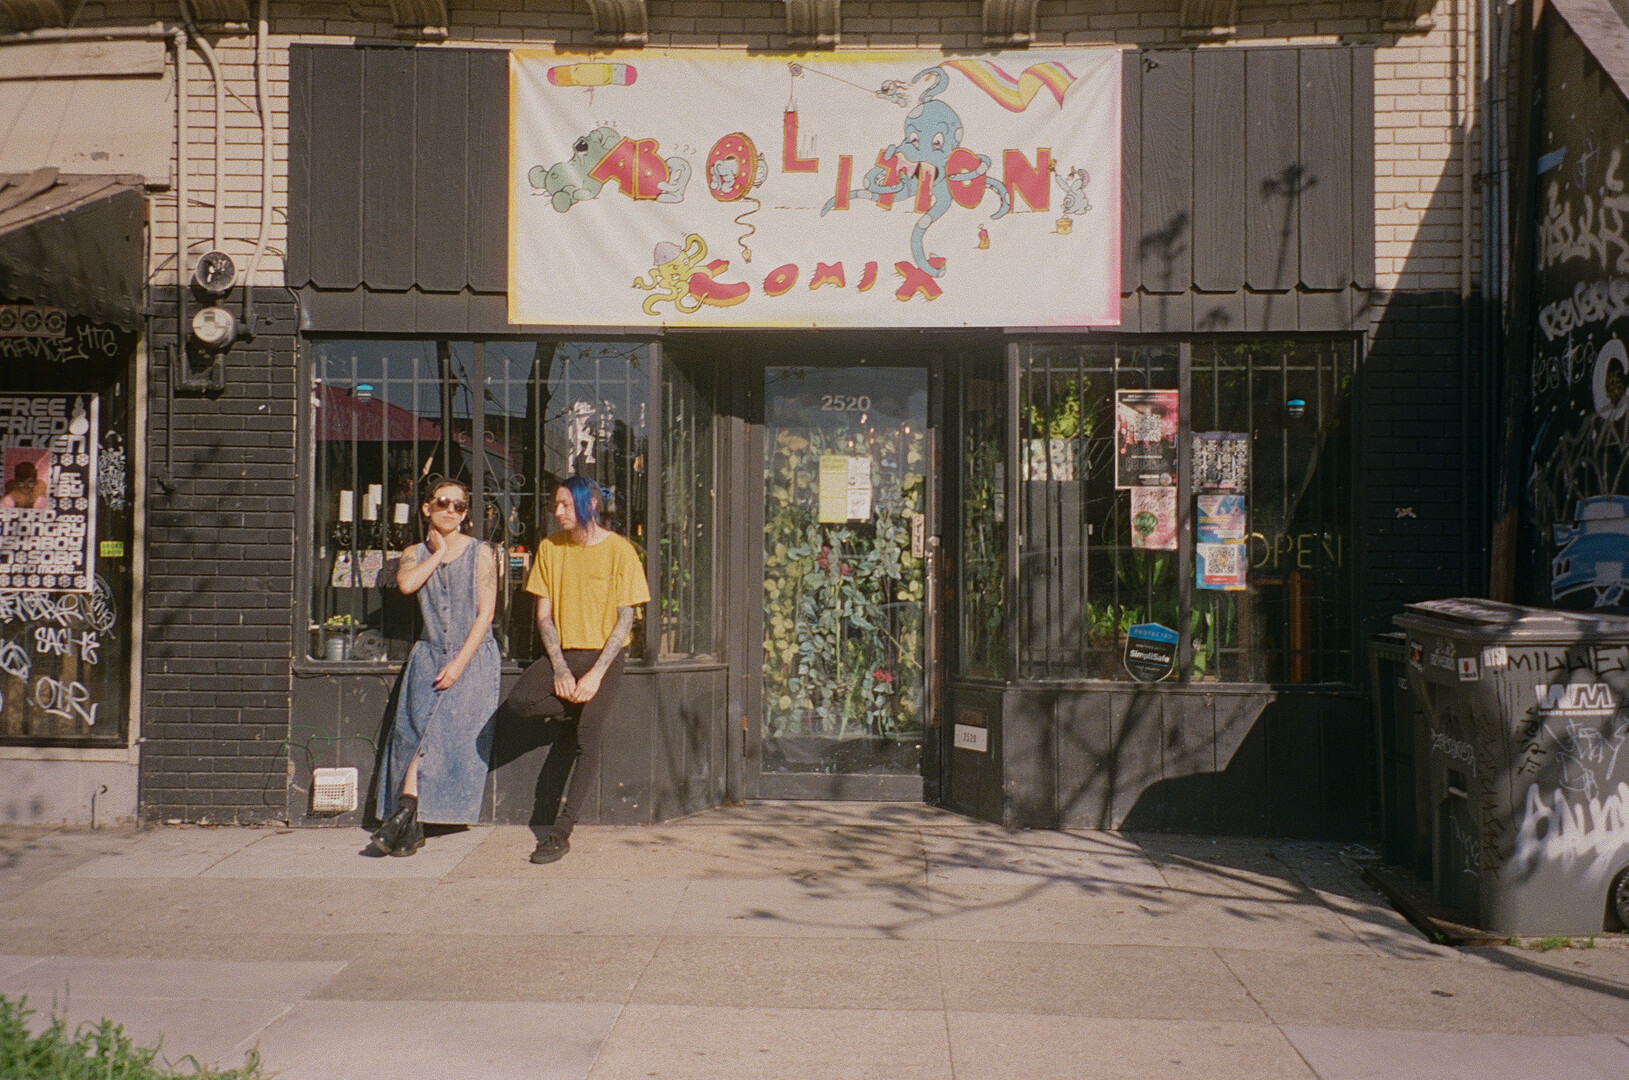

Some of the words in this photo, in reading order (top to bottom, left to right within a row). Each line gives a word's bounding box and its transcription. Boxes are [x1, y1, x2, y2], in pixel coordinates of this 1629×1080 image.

[588, 110, 1051, 214] ABOLITION
[688, 258, 947, 307] COMIX
[821, 395, 872, 412] 2520
[1243, 532, 1342, 569] OPEN
[1129, 649, 1171, 664] SimpliSafe
